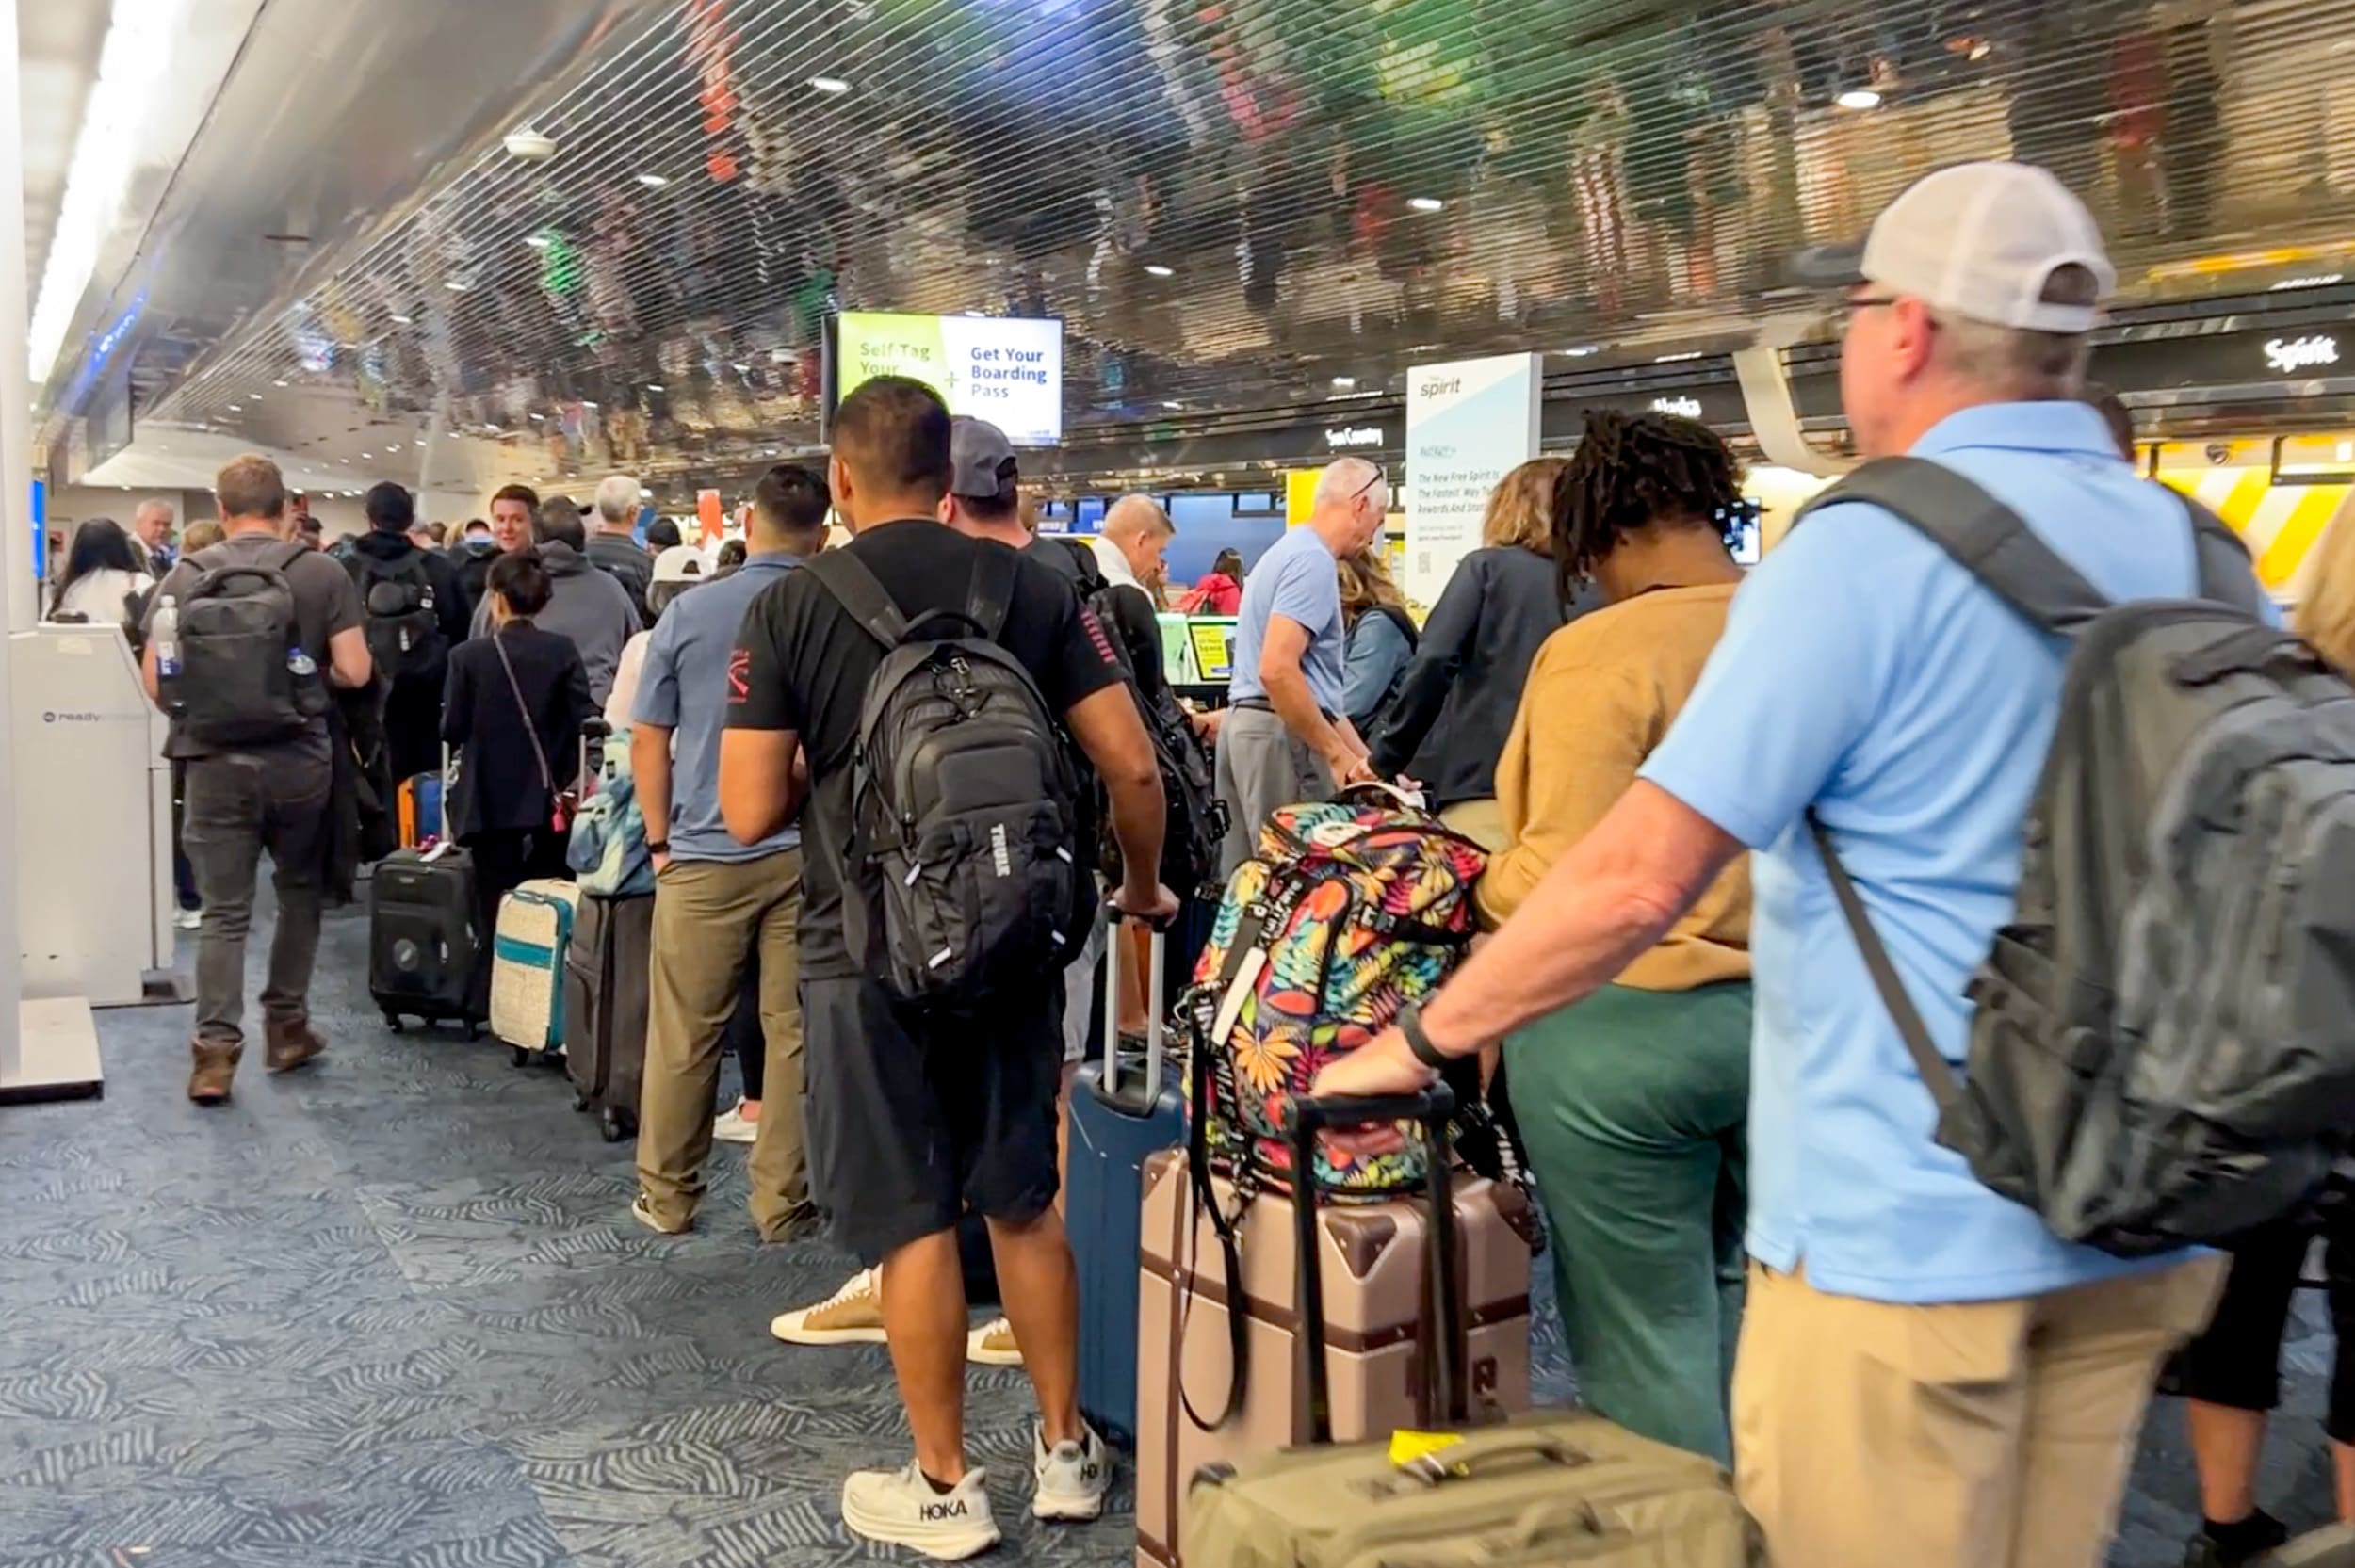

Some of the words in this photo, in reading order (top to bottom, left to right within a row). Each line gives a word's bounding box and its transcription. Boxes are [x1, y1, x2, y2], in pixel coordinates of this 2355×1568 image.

[860, 342, 894, 357] Self
[900, 344, 930, 362] Tag
[970, 347, 999, 361] Get
[1005, 348, 1044, 363] Your
[2264, 335, 2340, 373] Spirit
[860, 361, 899, 376] Your
[971, 365, 1047, 385] Boarding
[971, 384, 1009, 398] Pass
[1421, 377, 1461, 399] spirit
[1324, 428, 1346, 447] Sun
[1344, 427, 1384, 447] Country
[1080, 1463, 1098, 1482] HO
[920, 1499, 967, 1523] HOKA
